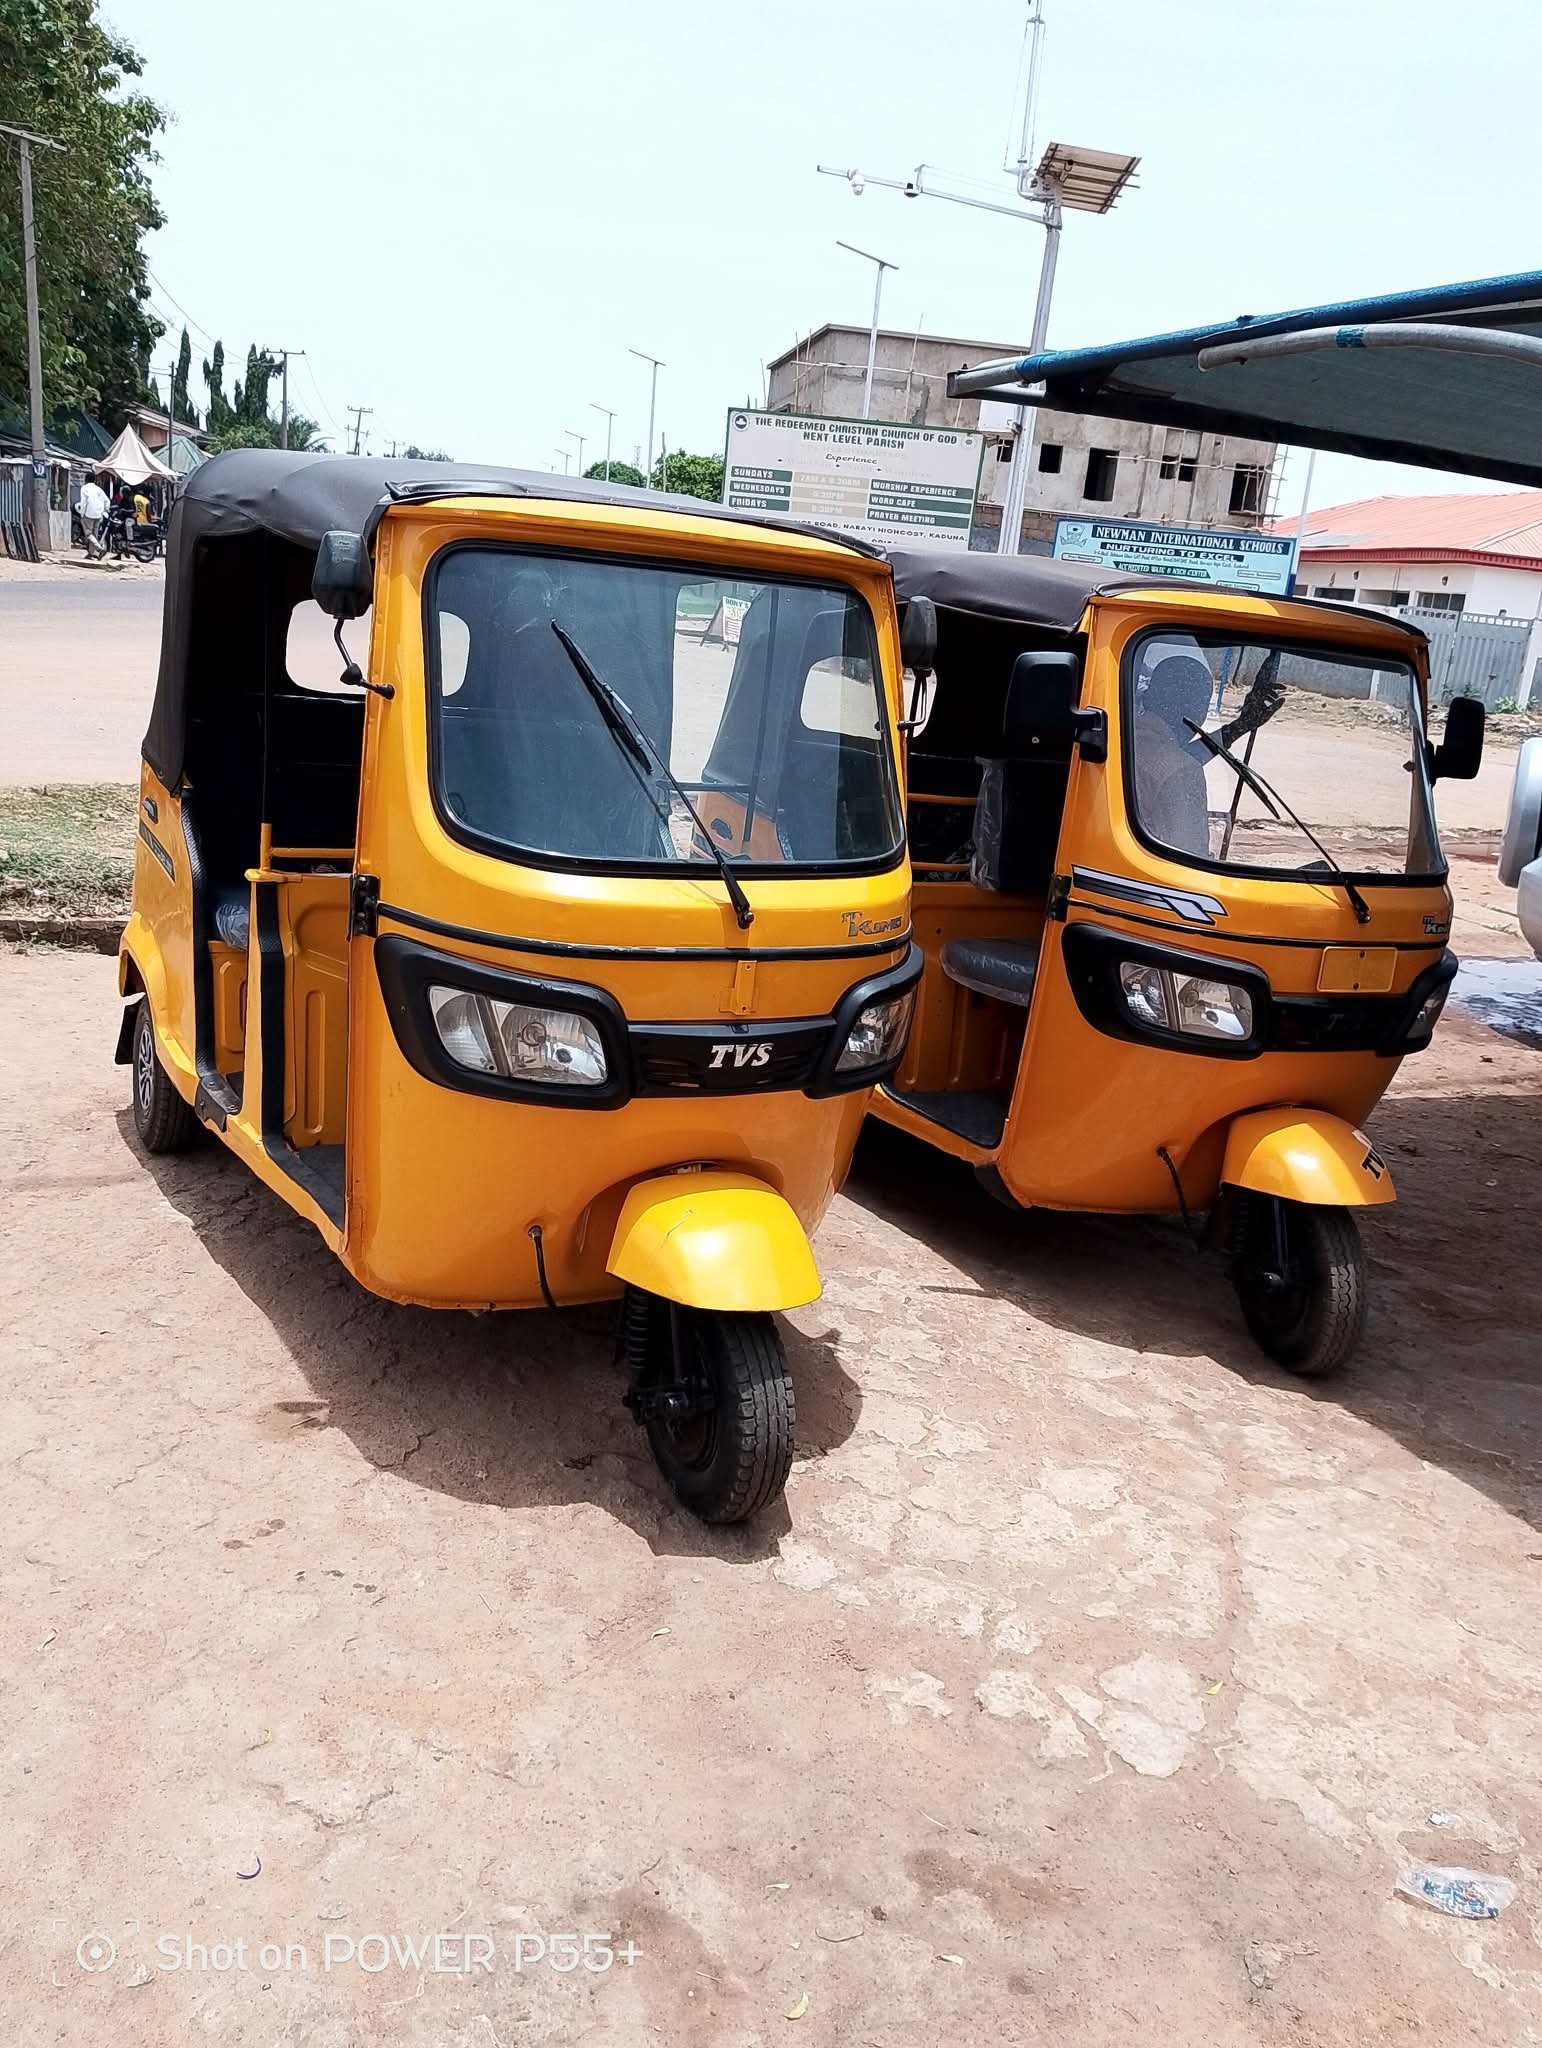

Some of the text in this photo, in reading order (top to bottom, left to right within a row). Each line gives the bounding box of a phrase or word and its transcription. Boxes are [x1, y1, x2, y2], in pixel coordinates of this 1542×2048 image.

[755, 417, 957, 444] THE REDEEMED CHRISTIAN CHURCH OF GOD
[803, 432, 905, 449] NEXT LEVEL PARISH
[825, 453, 877, 465] Experience
[734, 468, 773, 479] SUNDAYS
[733, 482, 784, 494] WEDNESDAYS
[873, 480, 957, 497] WORSHIP EXPERIENCE
[732, 498, 767, 508] FRIDAYS
[871, 496, 916, 508] WORD CAFE
[869, 510, 936, 524] PRAYER MEETING
[1096, 526, 1284, 554] NEWMAN INTERNATIONAL SCHOOLS
[1106, 543, 1175, 555] NURTURING
[1180, 550, 1195, 558] TO
[1200, 553, 1238, 562] EXCEL
[708, 1043, 775, 1068] TVS
